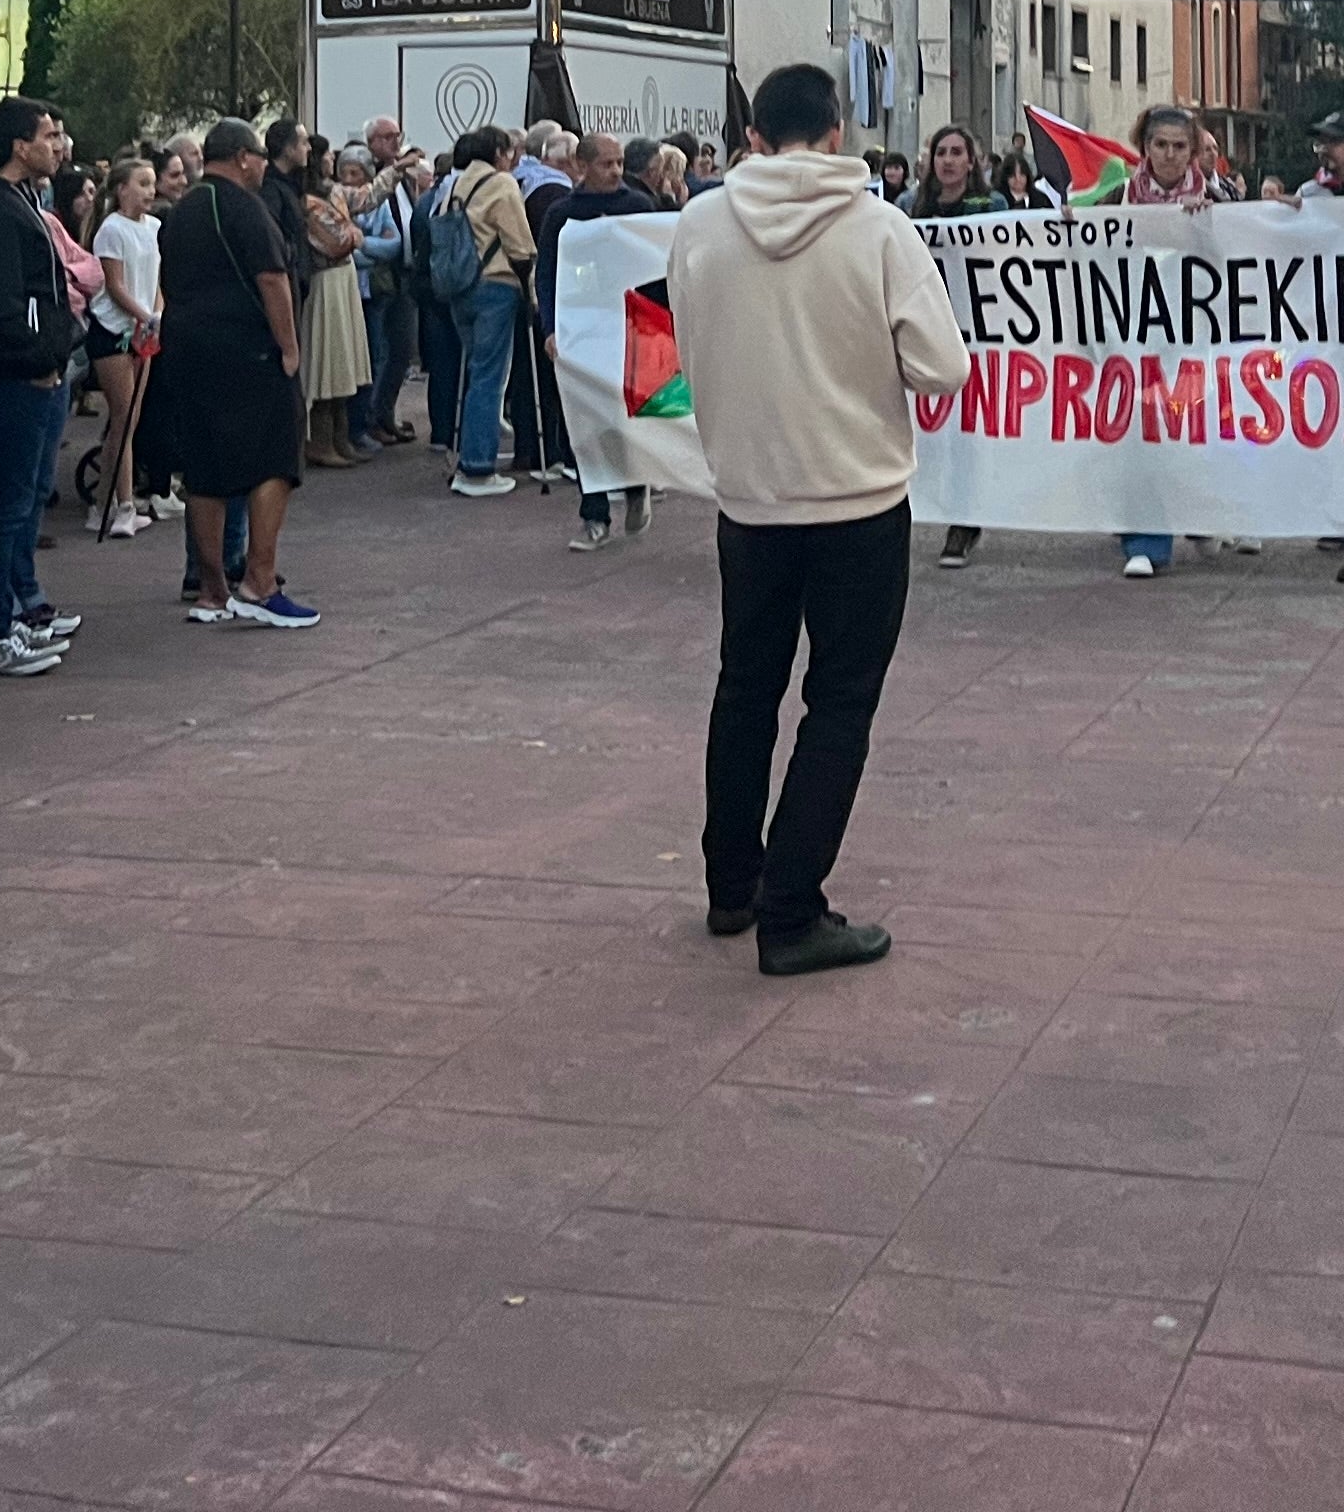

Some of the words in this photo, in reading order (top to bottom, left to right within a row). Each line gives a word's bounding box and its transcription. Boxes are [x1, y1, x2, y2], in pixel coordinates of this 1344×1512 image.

[578, 99, 641, 134] HURRERÍA
[663, 106, 678, 134] LA
[681, 107, 720, 136] BUENA
[914, 220, 1033, 248] ZIDIOA
[1044, 218, 1134, 248] STOP!
